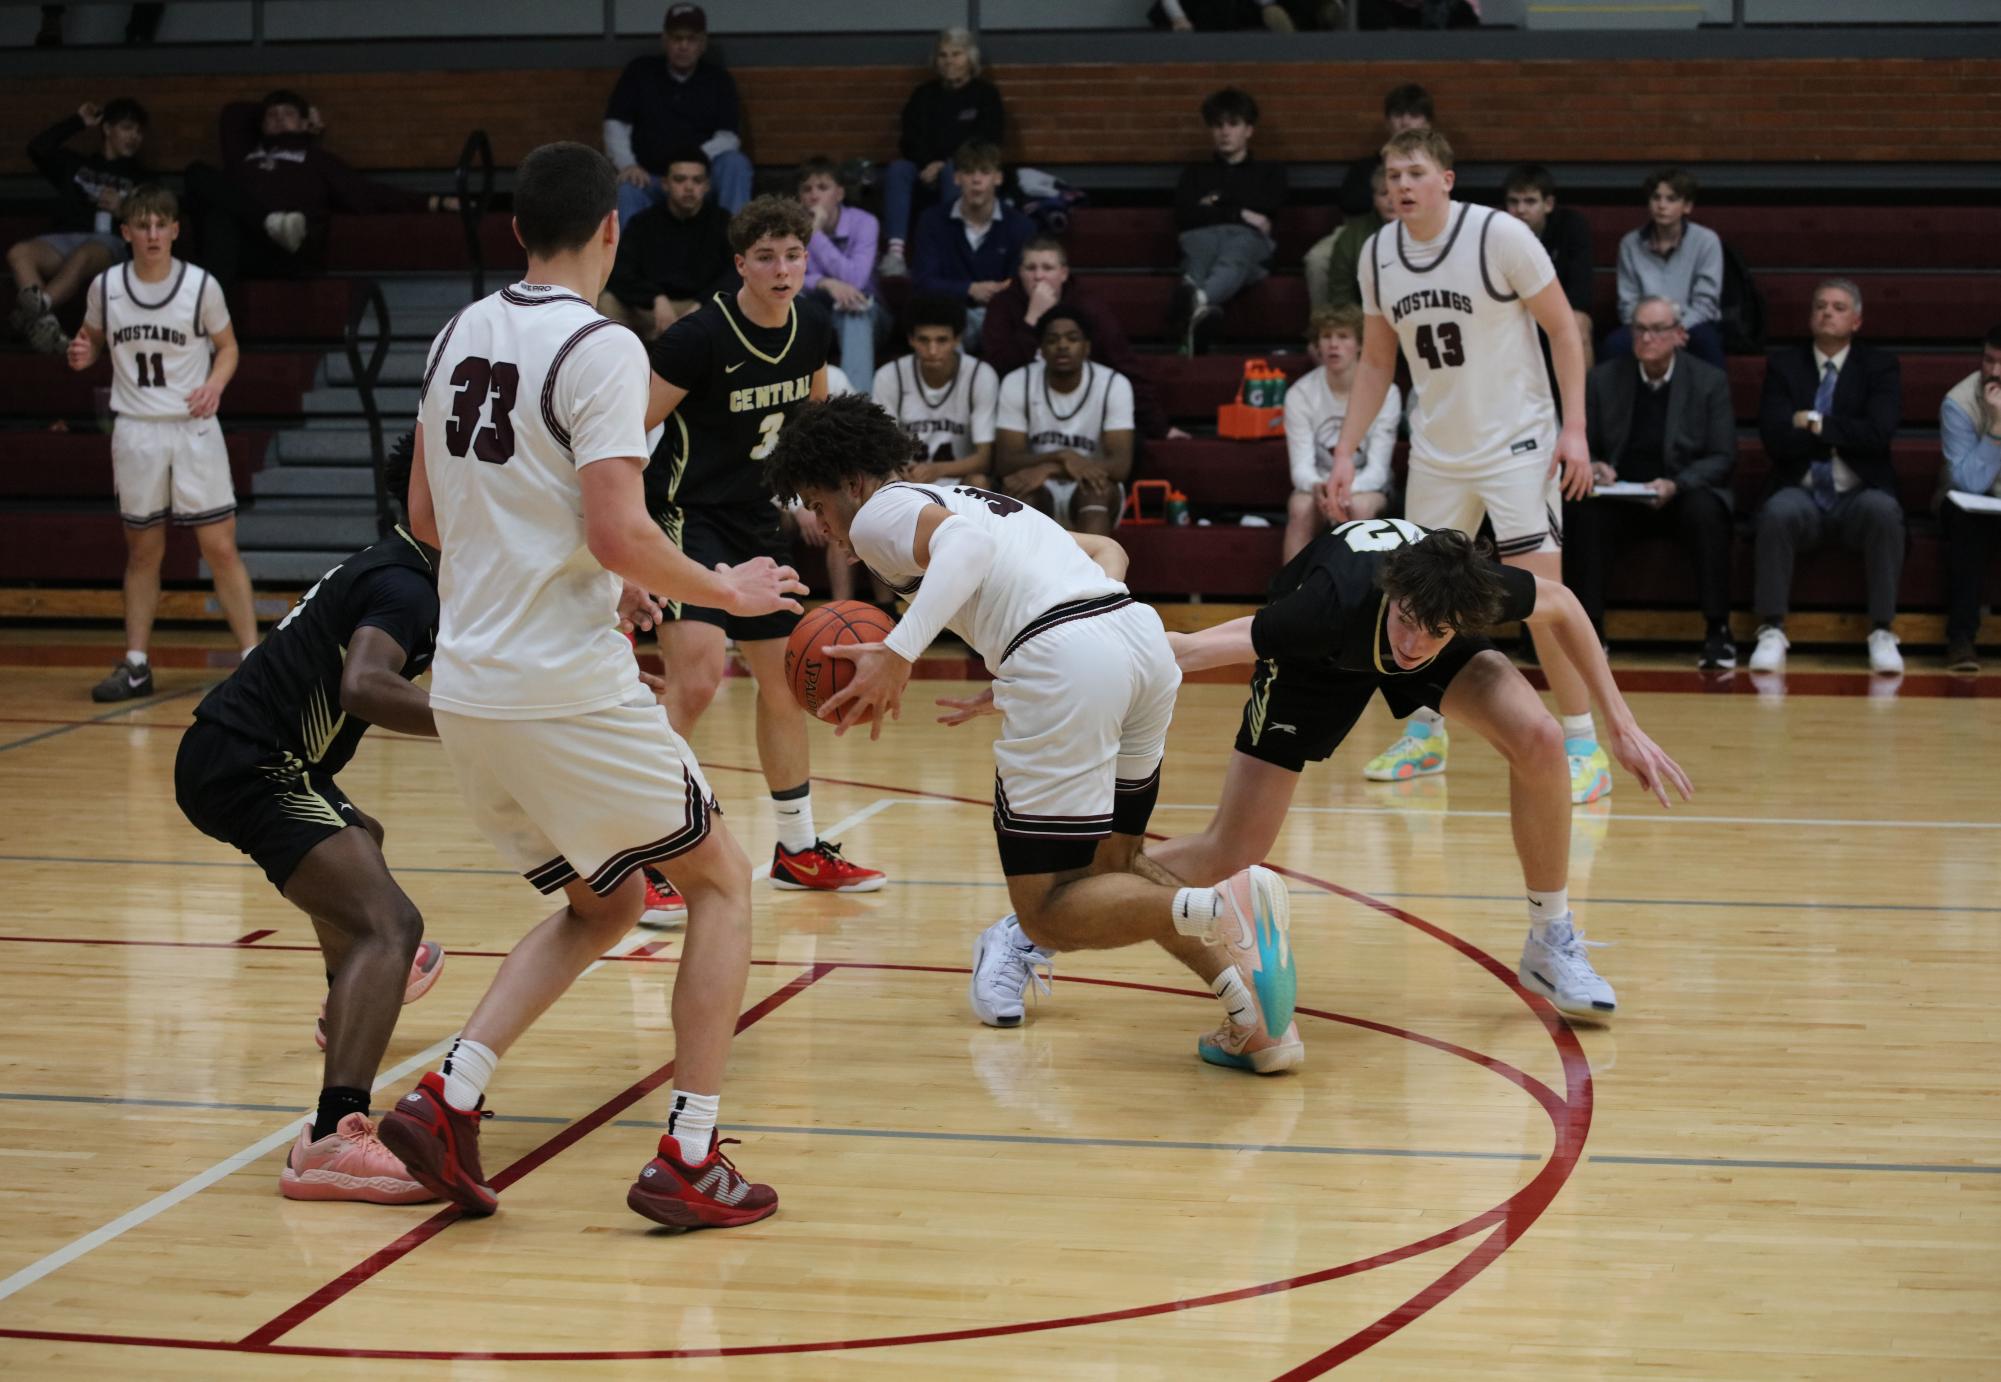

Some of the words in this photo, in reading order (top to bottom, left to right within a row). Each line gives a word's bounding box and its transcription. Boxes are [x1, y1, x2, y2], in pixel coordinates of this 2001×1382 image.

[1392, 289, 1473, 324] MUSTANGS
[113, 325, 187, 346] MUSTANGS
[1416, 321, 1466, 370] 43
[135, 352, 167, 387] 11
[446, 356, 520, 465] 33
[729, 375, 810, 413] CENTRAL
[750, 412, 785, 460] 3
